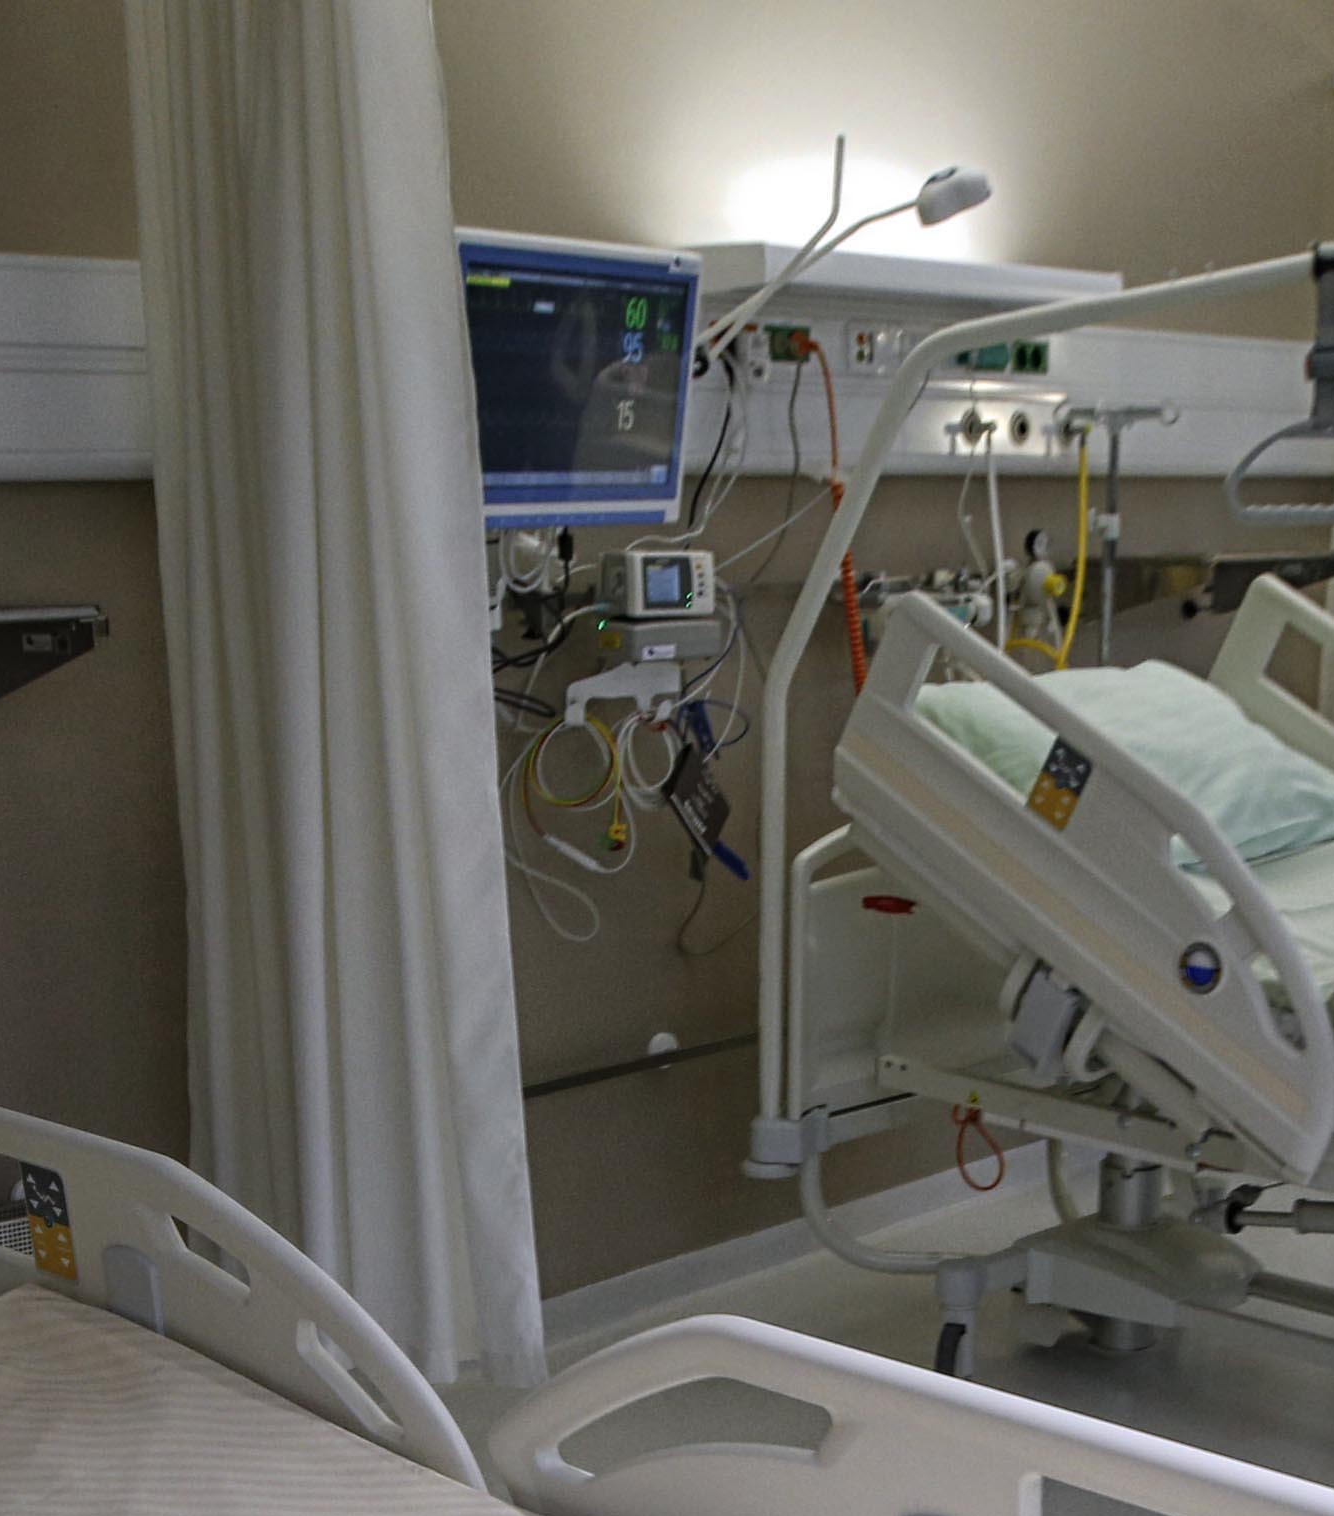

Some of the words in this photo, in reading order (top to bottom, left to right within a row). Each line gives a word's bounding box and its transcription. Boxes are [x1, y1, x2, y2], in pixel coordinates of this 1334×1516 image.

[625, 296, 647, 329] 60
[623, 332, 643, 364] 95
[616, 399, 635, 431] 15
